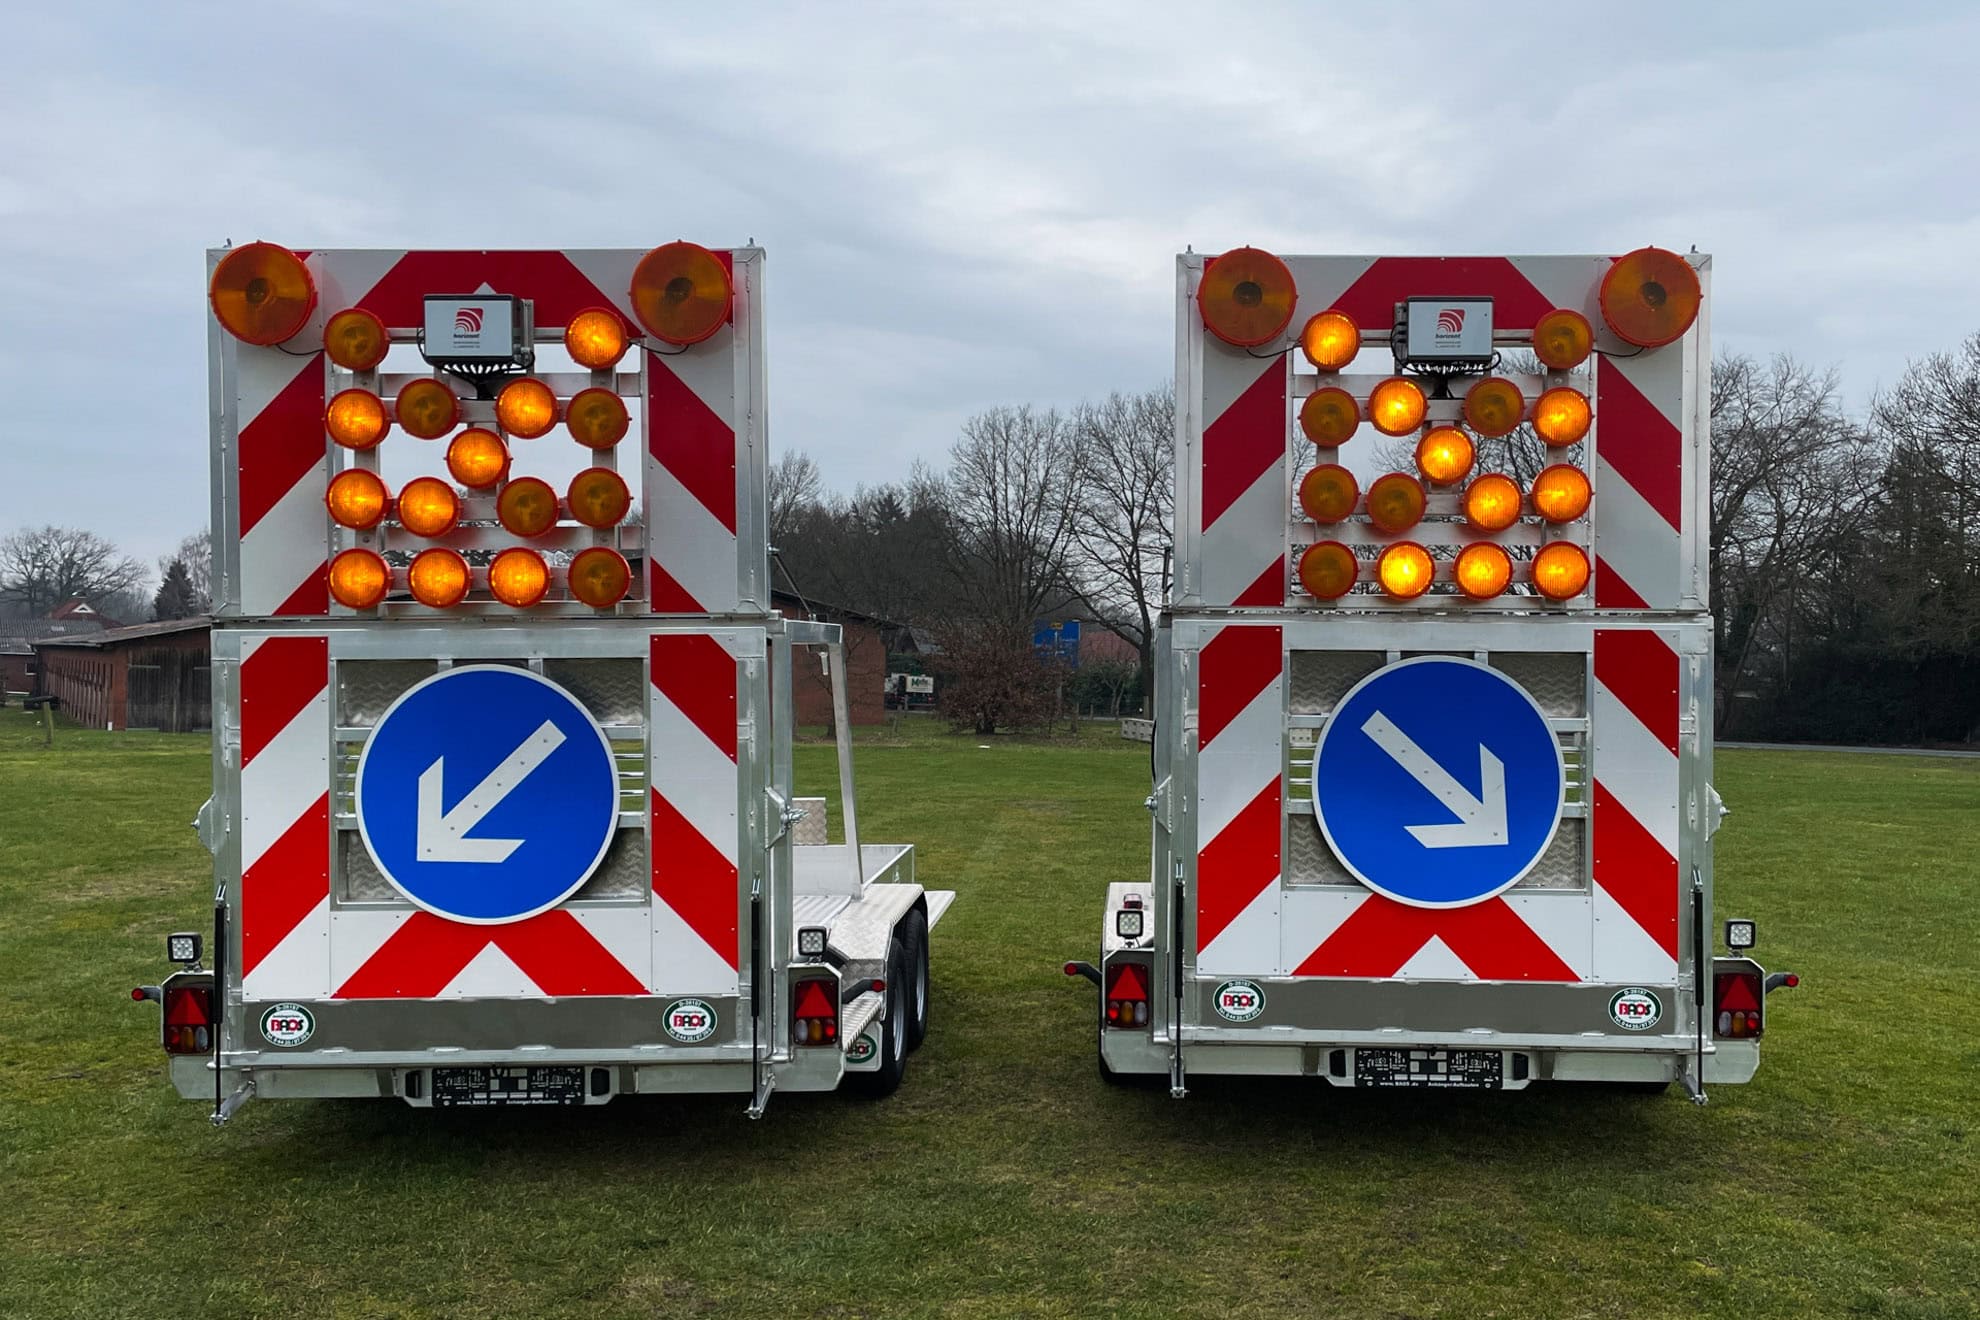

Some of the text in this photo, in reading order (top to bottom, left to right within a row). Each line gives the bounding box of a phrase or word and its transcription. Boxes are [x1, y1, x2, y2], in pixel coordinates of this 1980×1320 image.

[1224, 995, 1255, 1006] BAOS
[1619, 1003, 1652, 1015] BAOS
[271, 1019, 304, 1031] BAOS
[674, 1015, 706, 1027] BAOS
